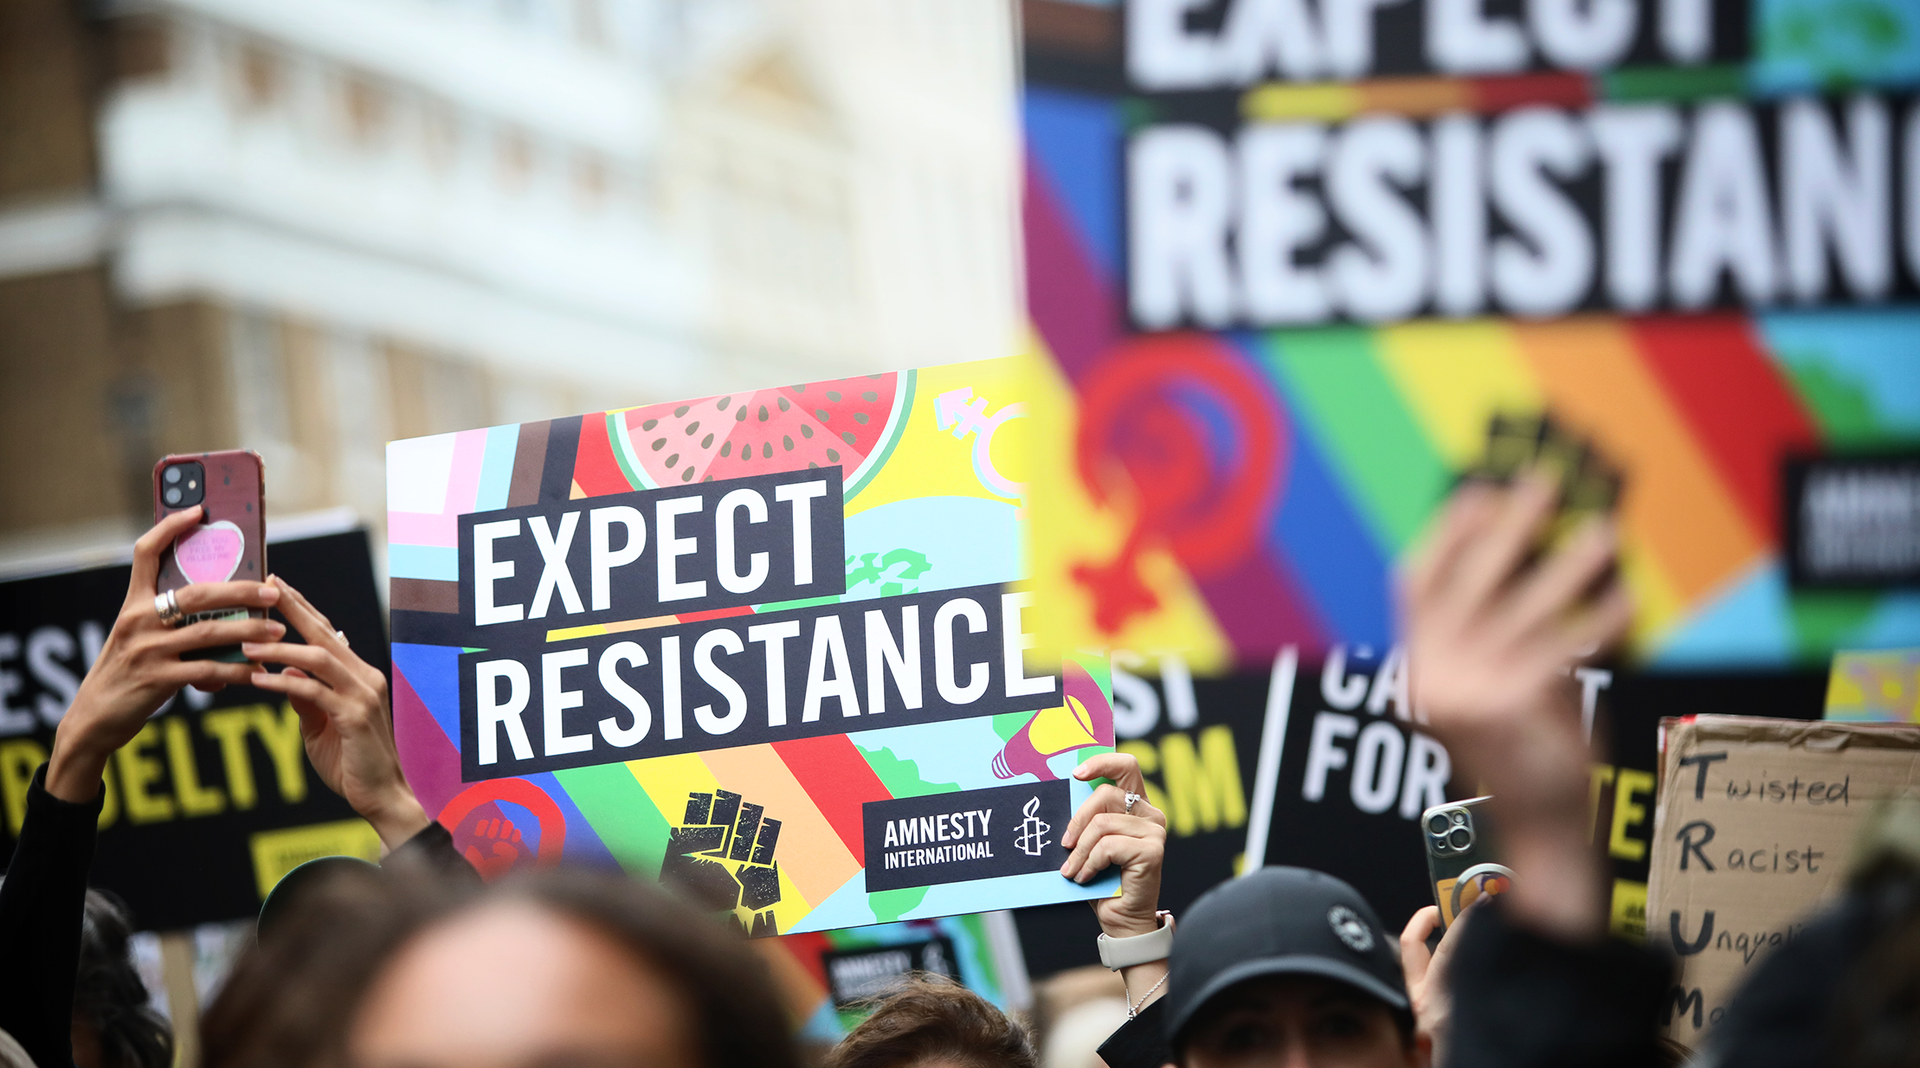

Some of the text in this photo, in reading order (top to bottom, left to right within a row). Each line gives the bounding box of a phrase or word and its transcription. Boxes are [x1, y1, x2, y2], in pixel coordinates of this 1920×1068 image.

[1124, 95, 1920, 330] RESISTAN
[210, 535, 229, 544] YOU
[473, 479, 827, 626] EXPECT
[475, 590, 1056, 766] RESISTANCE
[1302, 710, 1452, 822] FOR
[1678, 751, 1851, 807] Twisted
[883, 808, 993, 849] AMNESTY
[884, 840, 995, 871] INTERNATIONAL
[1674, 819, 1825, 874] Racist
